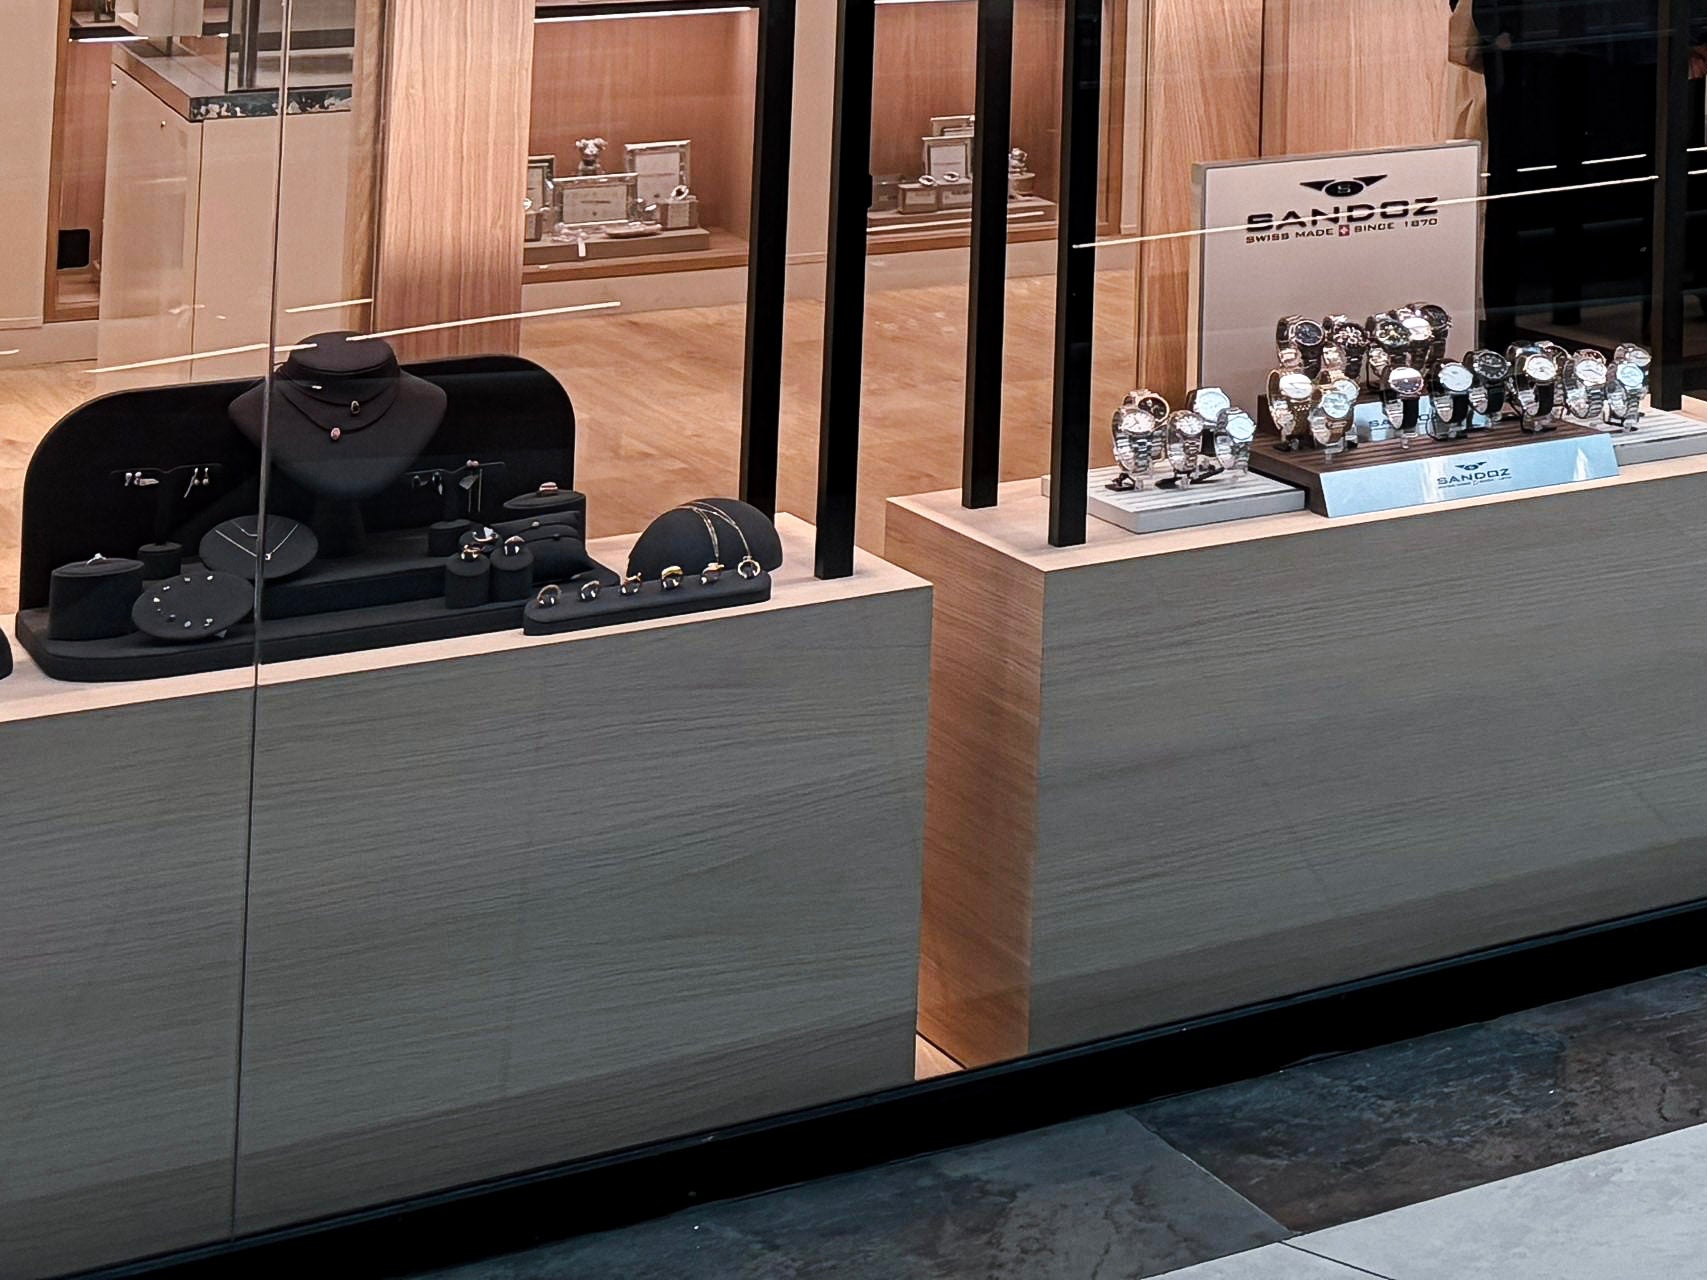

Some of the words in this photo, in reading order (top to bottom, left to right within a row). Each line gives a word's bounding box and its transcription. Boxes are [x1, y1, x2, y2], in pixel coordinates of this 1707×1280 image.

[1246, 196, 1439, 233] SANDOZ
[1246, 231, 1290, 244] SWISS
[1295, 228, 1334, 239] MADE
[1354, 221, 1396, 233] SINCE
[1404, 217, 1439, 229] 1870
[1436, 467, 1511, 485] SANDOZ
